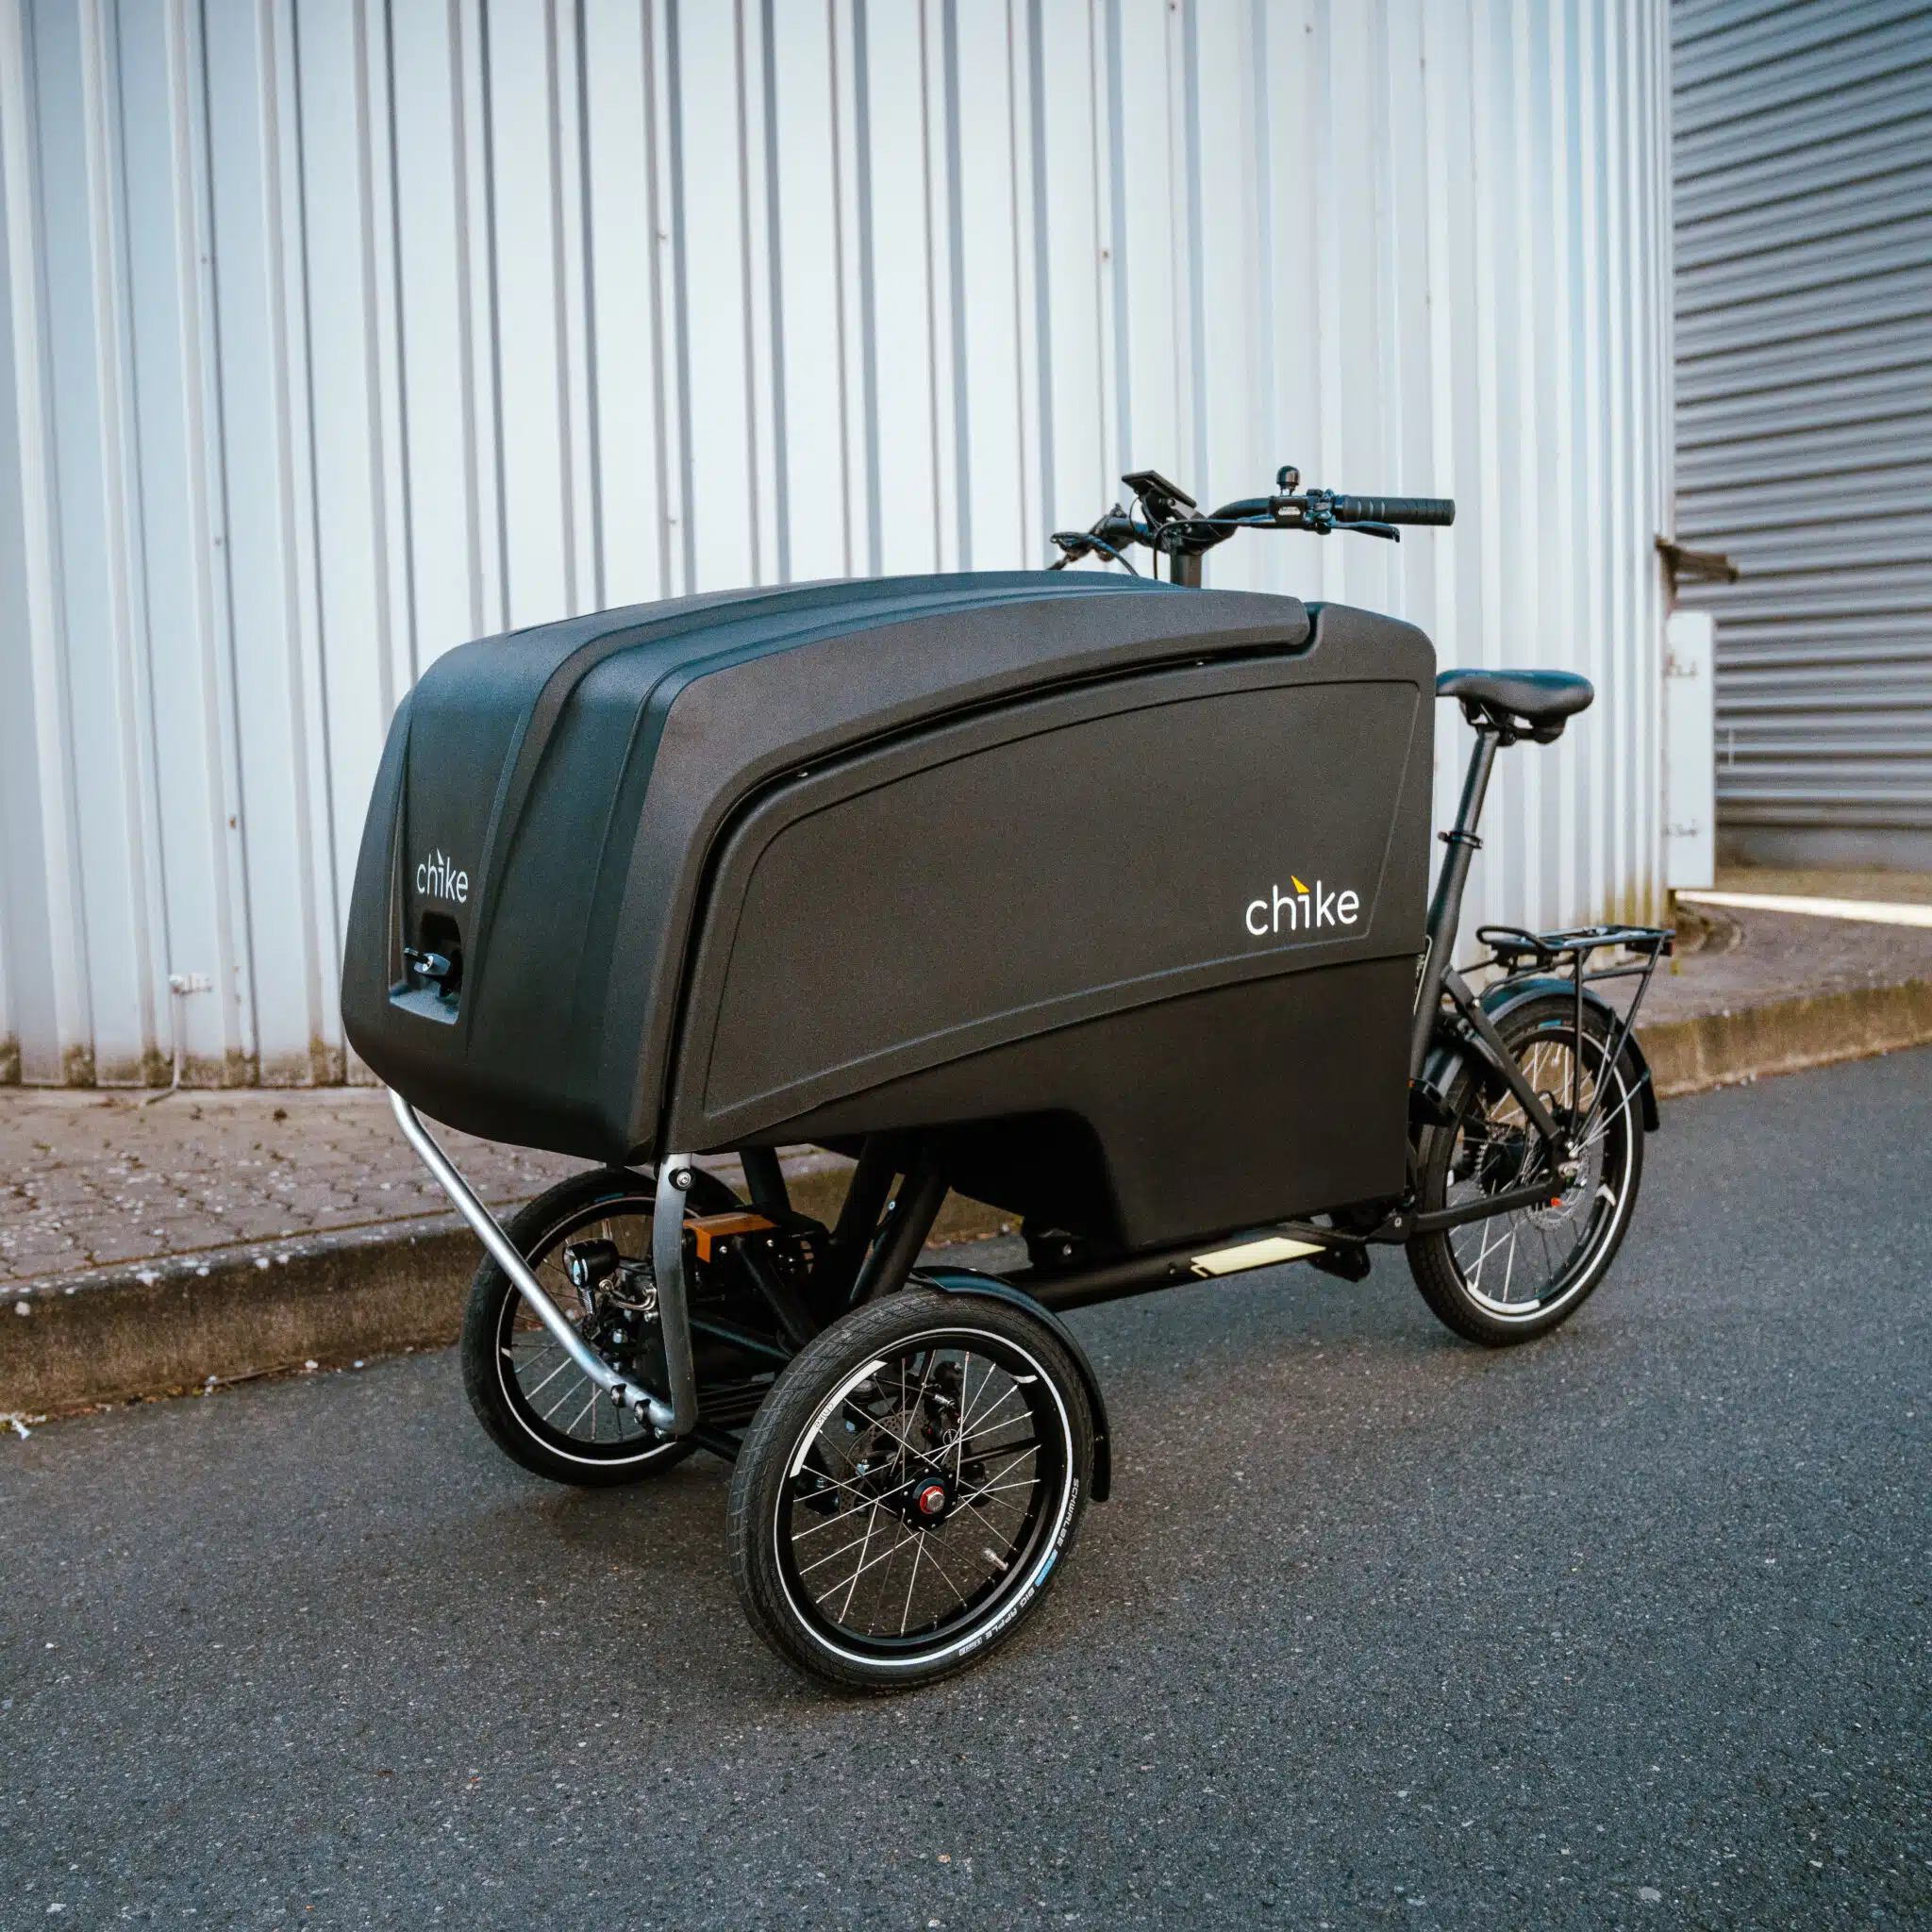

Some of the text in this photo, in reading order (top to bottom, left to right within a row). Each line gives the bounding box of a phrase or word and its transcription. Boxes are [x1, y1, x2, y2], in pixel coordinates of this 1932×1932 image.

[416, 847, 469, 904] chike
[1245, 874, 1359, 936] chike
[814, 1403, 834, 1428] chike
[985, 1477, 1080, 1640] SCHWALBE BIG APPLE
